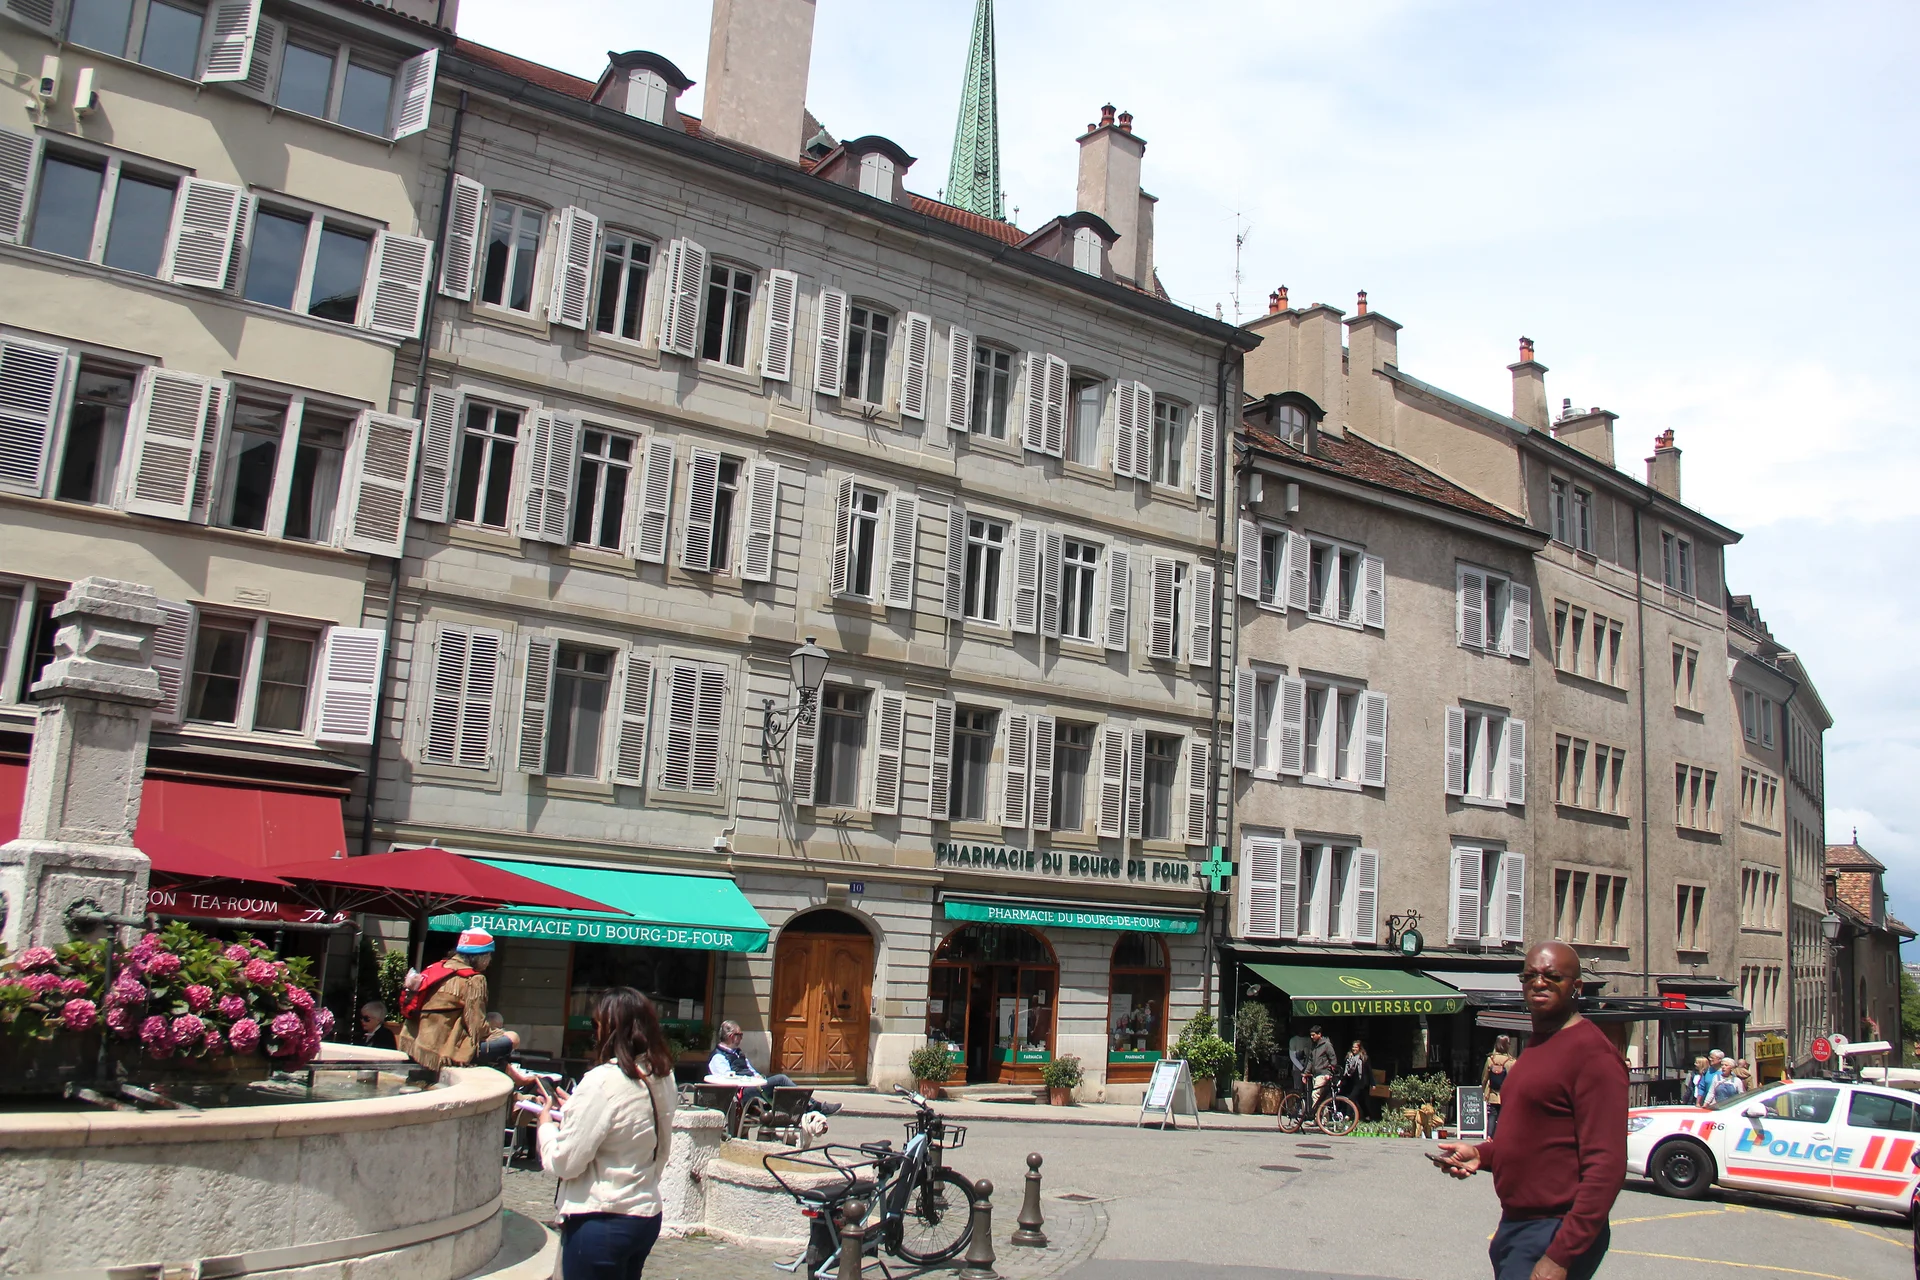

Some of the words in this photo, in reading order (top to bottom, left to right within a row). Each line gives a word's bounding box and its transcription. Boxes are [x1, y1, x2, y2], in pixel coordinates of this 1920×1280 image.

[937, 843, 1034, 868] PHARMACIE
[1042, 853, 1063, 871] DU
[1069, 855, 1120, 876] BOURG
[1128, 860, 1146, 877] DE
[1152, 862, 1188, 880] FOUR
[853, 884, 862, 892] 10
[191, 894, 279, 913] TEA-ROOM
[988, 907, 1054, 922] PHARMACIE
[1058, 912, 1074, 923] DU
[1077, 913, 1161, 929] BOURG-DE-FOUR
[470, 915, 572, 935] PHARMACIE
[577, 923, 601, 937] DU
[605, 925, 733, 946] BOURG-DE-FOUR
[1332, 1000, 1432, 1013] OLIVIERS&CO
[1705, 1122, 1725, 1131] 166
[1735, 1128, 1853, 1164] POLICE
